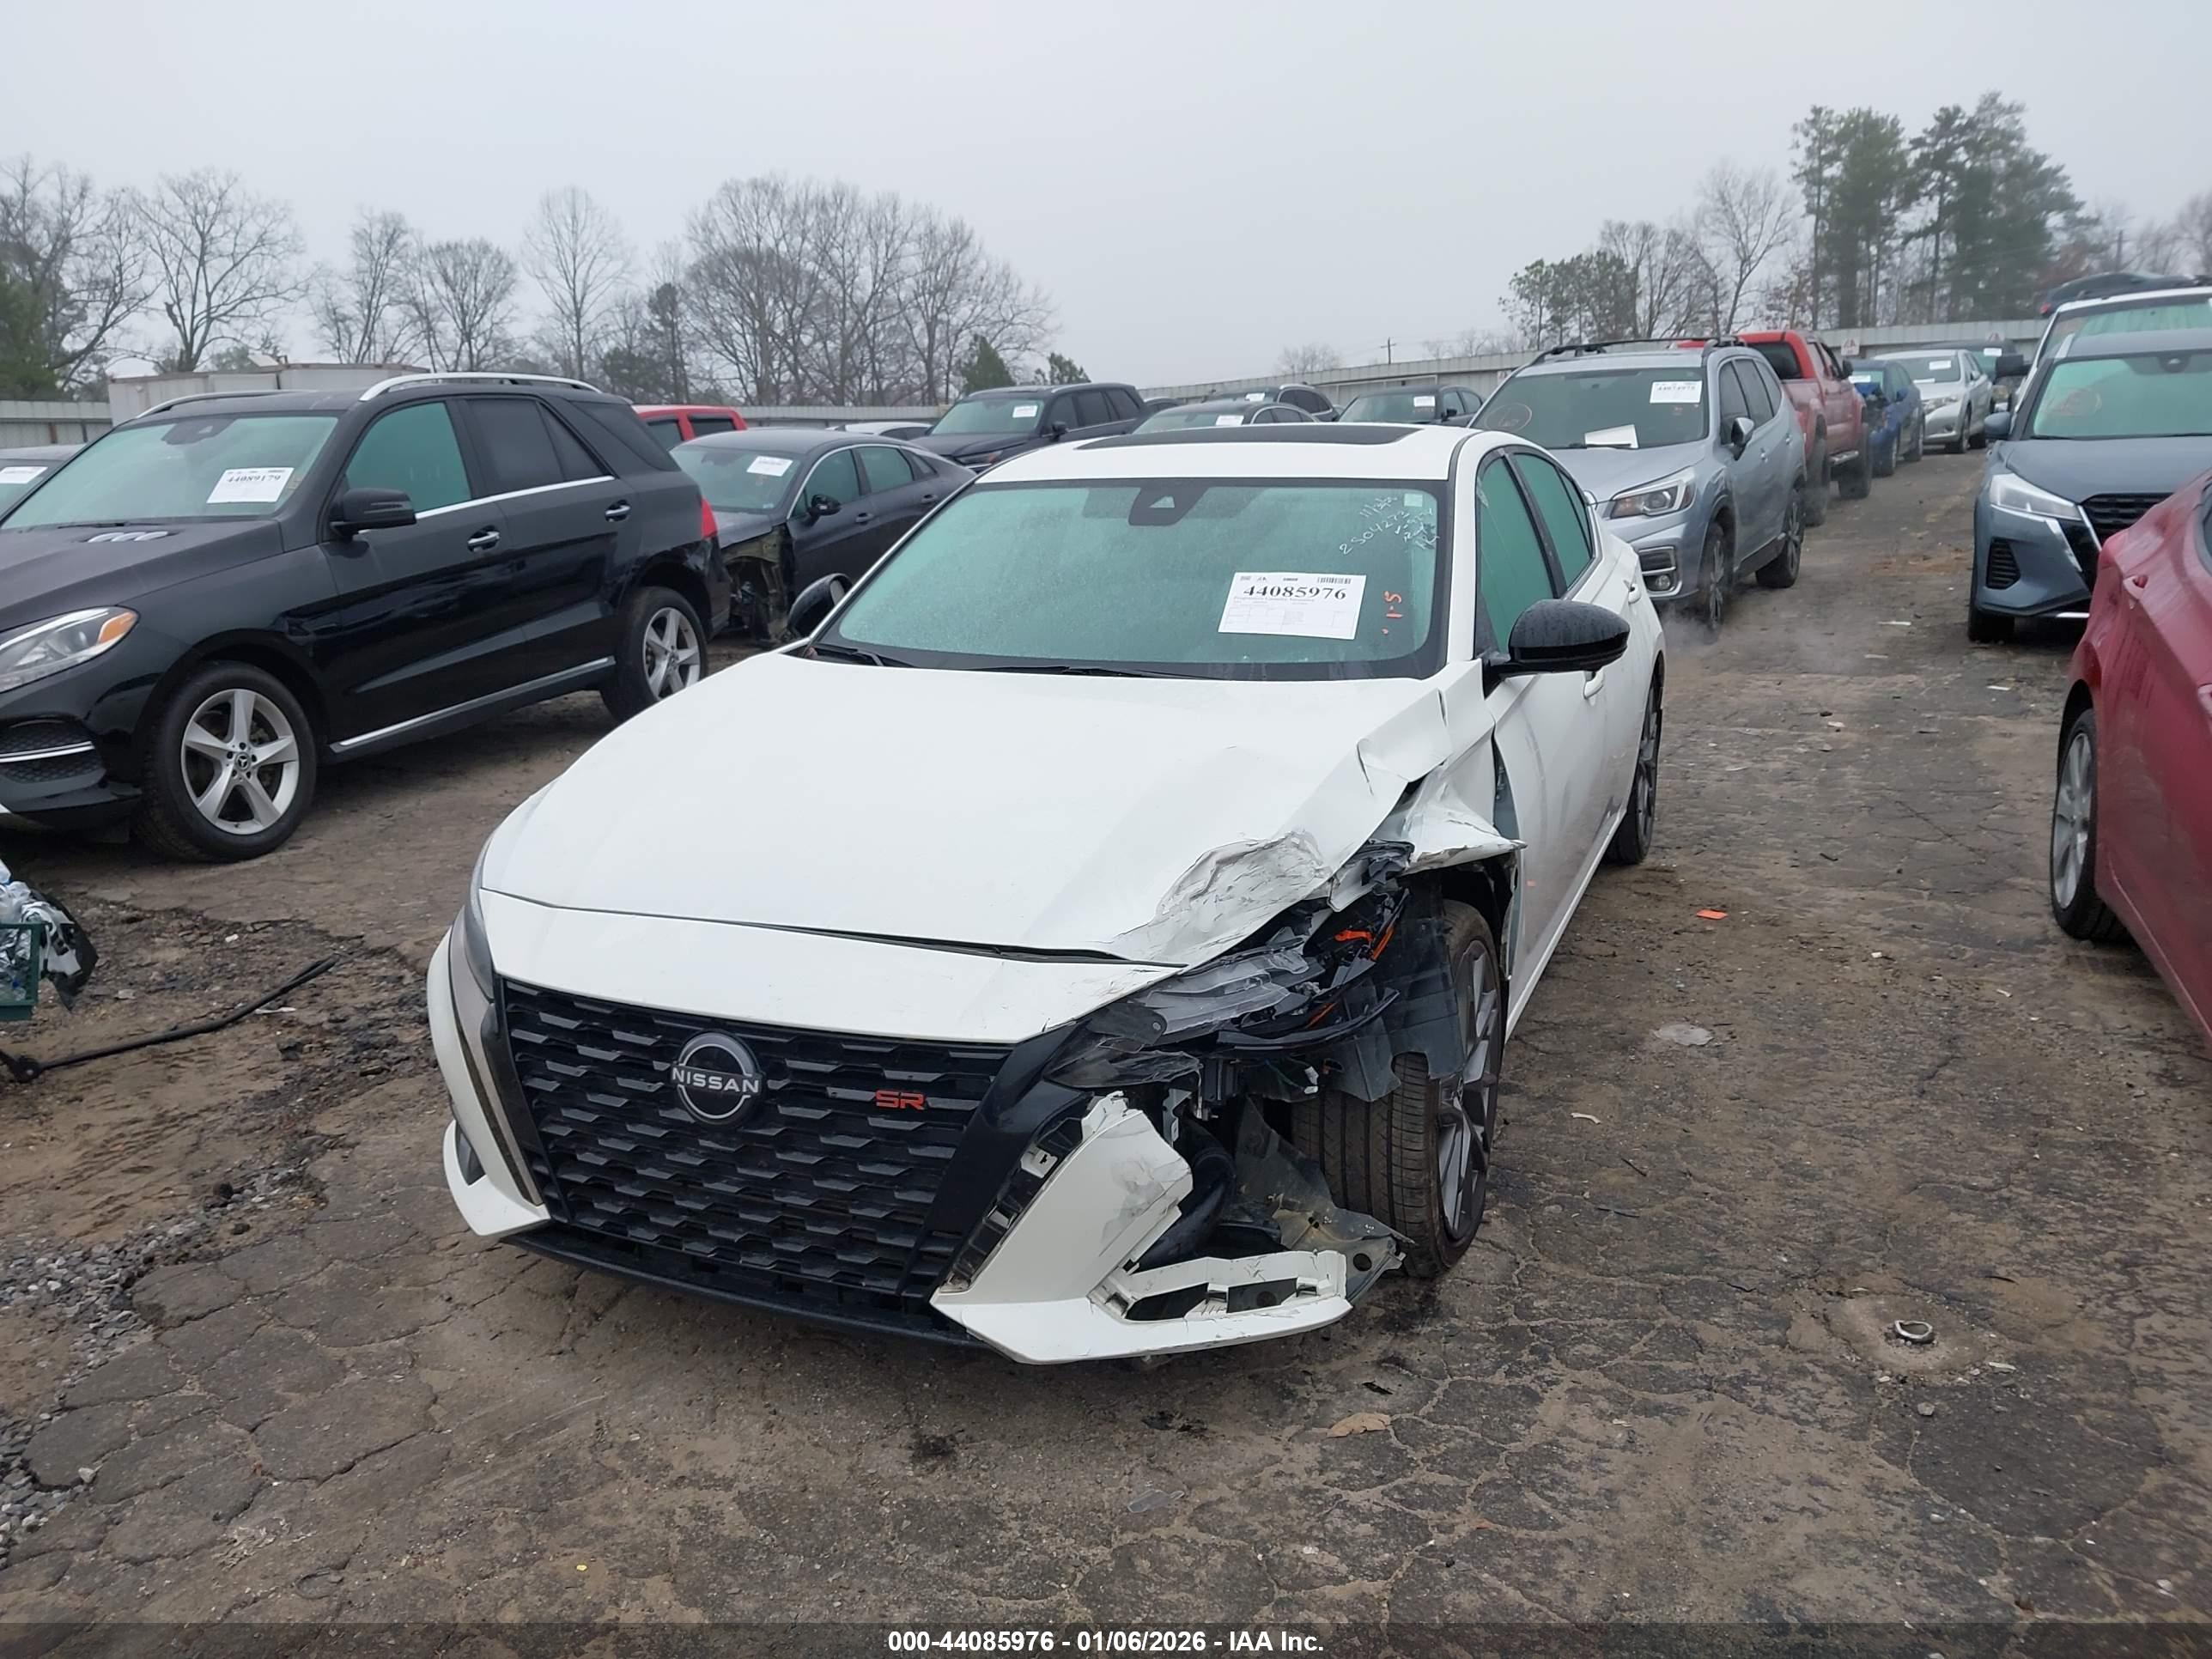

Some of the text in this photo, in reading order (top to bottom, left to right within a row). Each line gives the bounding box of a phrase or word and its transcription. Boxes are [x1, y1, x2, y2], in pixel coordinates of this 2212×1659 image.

[1243, 585, 1347, 600] 44085976
[672, 1067, 759, 1093] NISSAN
[876, 1090, 926, 1110] SR
